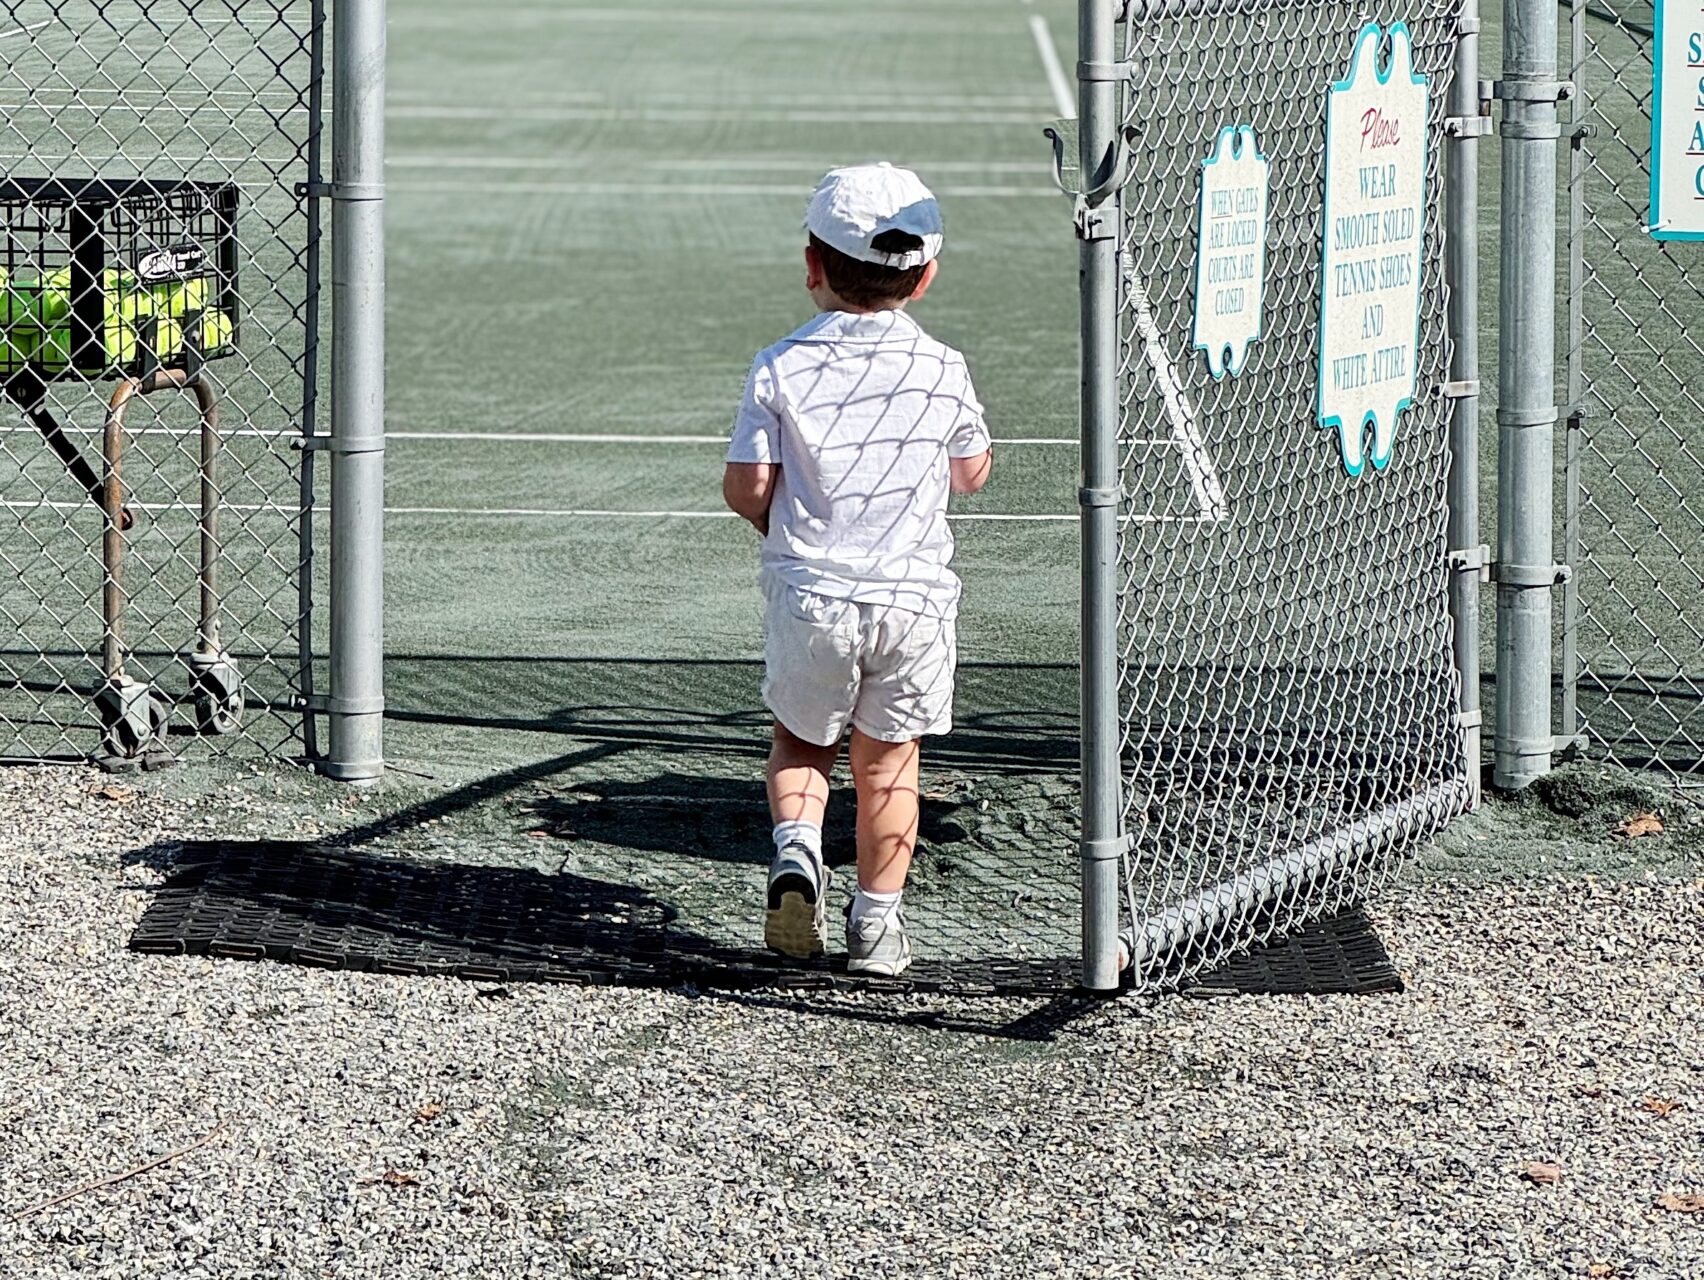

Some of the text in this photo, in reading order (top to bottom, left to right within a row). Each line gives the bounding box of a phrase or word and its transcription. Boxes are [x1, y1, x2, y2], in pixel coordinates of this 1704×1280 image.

[1360, 107, 1400, 153] Please
[1359, 164, 1396, 200] WEAR
[1210, 187, 1259, 217] WHEN GATES
[1208, 219, 1257, 249] ARE LOCKED
[1334, 207, 1414, 251] SMOOTH SOLED
[1208, 253, 1255, 284] COURTS ARE
[1335, 252, 1412, 298] TENNIS SHOES
[1214, 287, 1244, 316] CLOSED
[1361, 303, 1384, 340] AND
[1332, 344, 1407, 392] WHITE ATTIRE
